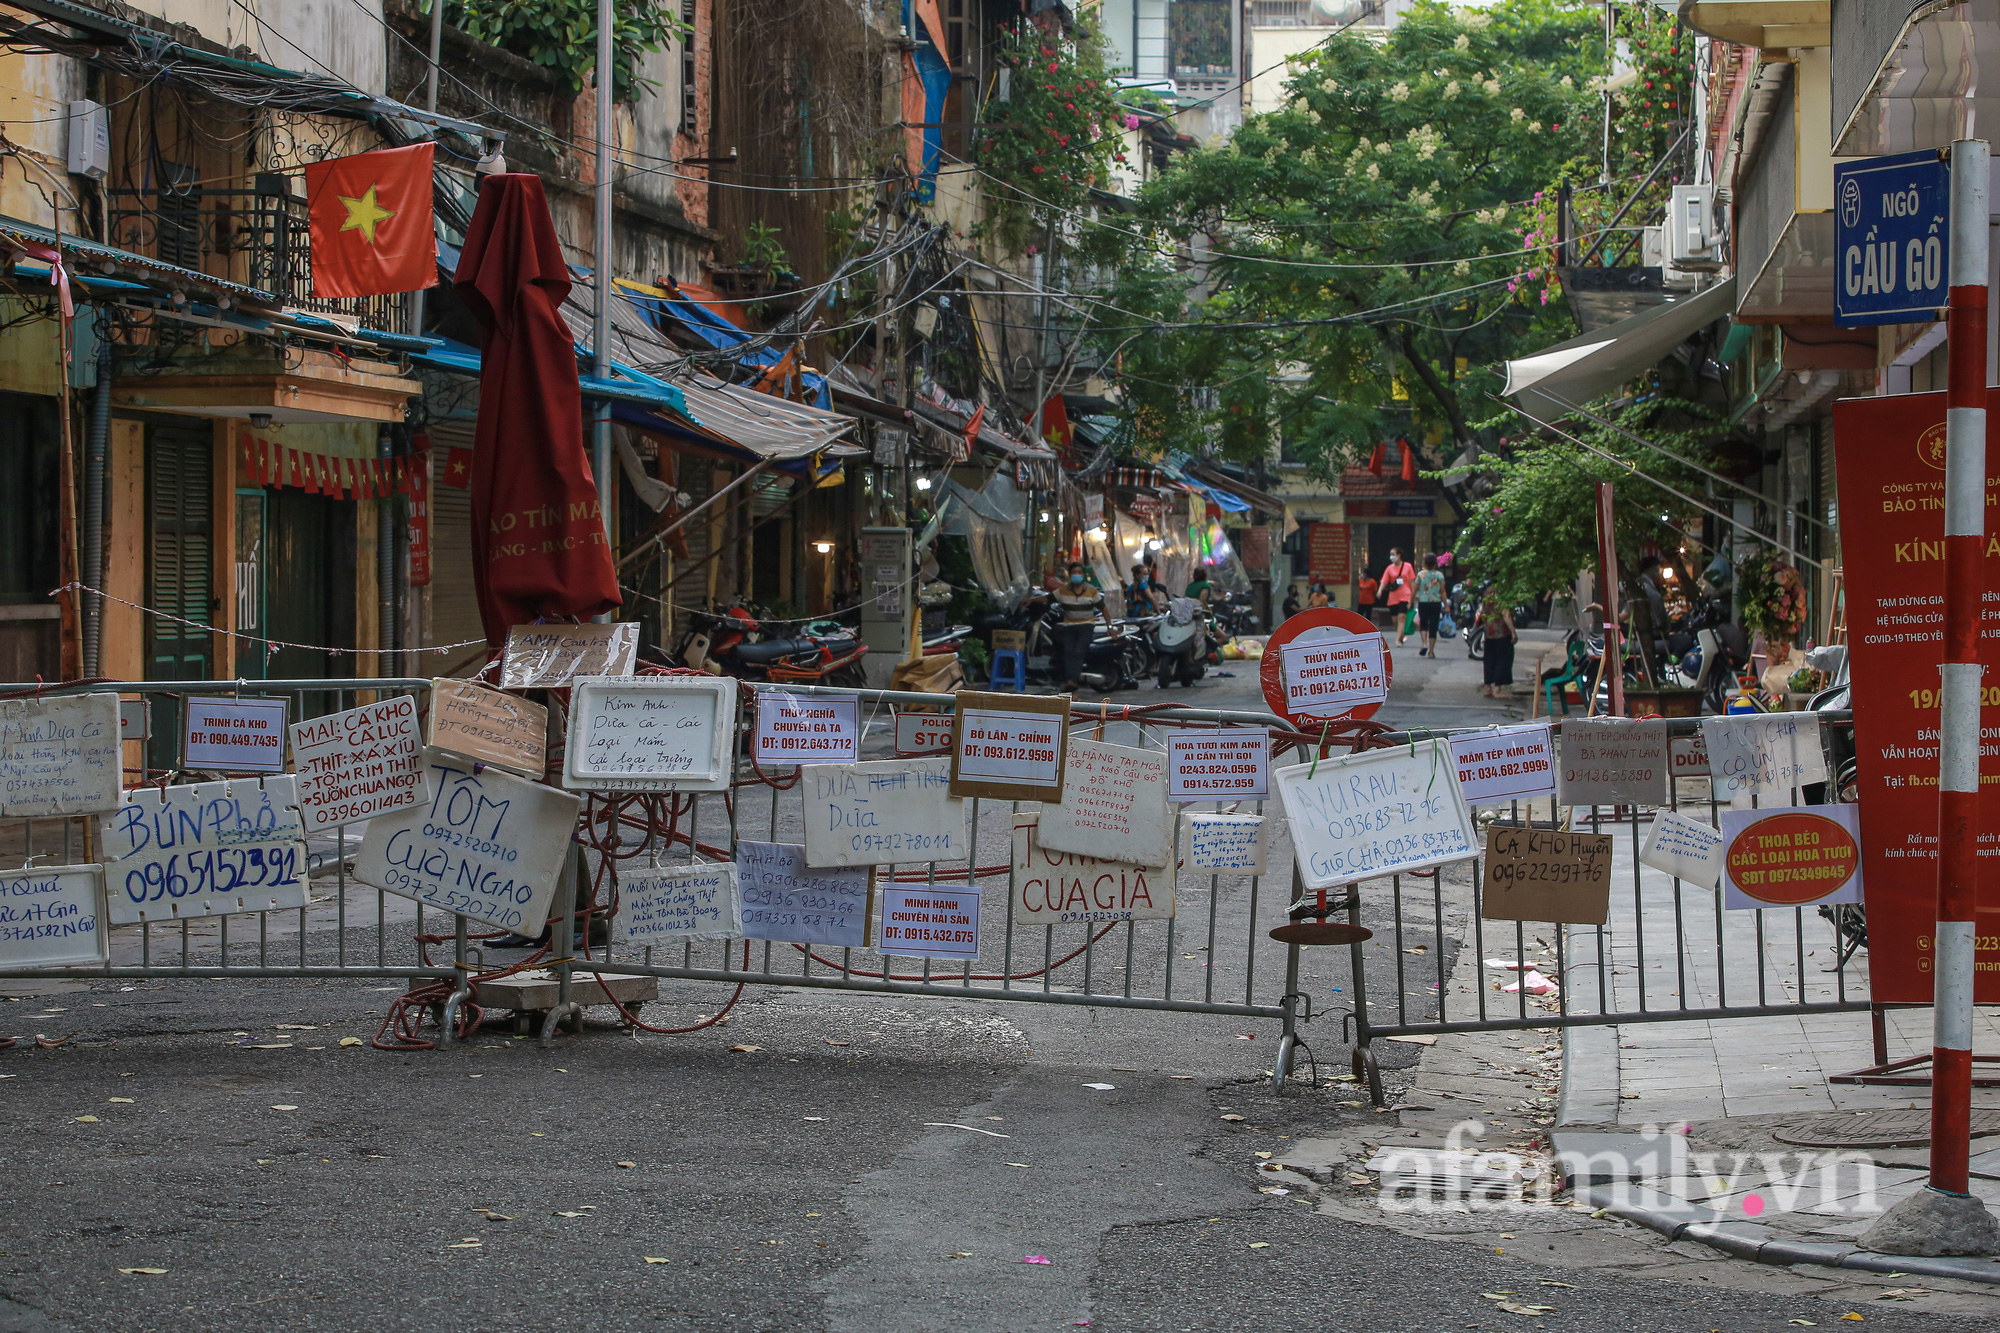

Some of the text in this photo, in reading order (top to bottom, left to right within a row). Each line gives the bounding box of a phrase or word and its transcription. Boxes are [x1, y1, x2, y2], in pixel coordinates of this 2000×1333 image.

[1883, 183, 1919, 218] NGÕ
[1845, 215, 1944, 297] CẦU GỖ
[1882, 482, 1928, 494] CÔNG TY
[1883, 494, 1945, 513] BẢO TÍN
[1877, 594, 1927, 609] TẠM DỪNG
[1877, 614, 1889, 627] HỆ
[1890, 612, 1923, 625] THỐNG
[1864, 631, 1929, 644] COVID-19 THEO
[1303, 648, 1360, 664] THỦY NGHĨA
[1300, 661, 1368, 679] CHUYÊN GÀ TA
[1290, 675, 1381, 698] ĐT: 0912.643.712
[605, 696, 636, 711] Kim
[203, 715, 268, 729] TRINH CÁ KHO
[806, 709, 836, 719] NGHĨA
[297, 701, 413, 746] MAI: CÁ KHO
[773, 720, 842, 734] CHUYÊN GÀ TA
[190, 731, 278, 748] ĐT: 090.449.7435
[348, 719, 412, 747] CÁ LỤC
[914, 731, 952, 747] STO
[970, 728, 1052, 744] BÒ LÂN CHỈNH
[1917, 726, 1941, 740] BÁN
[761, 737, 852, 750] ĐT: 0912.643.712
[1175, 740, 1261, 751] HOA TƯƠI KIM ANH
[1881, 743, 1939, 760] VẪN HOẠT
[307, 736, 416, 774] THỊT: XÁ XÍU
[965, 744, 1054, 763] ĐT: 093.612.9598
[1184, 750, 1252, 763] AI CẦN THÌ GỌI
[1459, 743, 1545, 765] MẮM TÉP KIM CHI
[1675, 750, 1709, 767] DỪN
[312, 754, 420, 790] TÔM THỊT
[1179, 763, 1258, 775] 0243.824.0596
[1459, 758, 1550, 784] ĐT: 034.682.9999
[1565, 769, 1653, 782] 0912635890
[1182, 777, 1255, 790] 0914.572.959
[1883, 775, 1905, 789] Tại:
[316, 790, 416, 824] 0396011443
[430, 764, 511, 841] TÔM
[114, 802, 202, 860] BÚN
[1758, 830, 1820, 849] THOA BÉO
[1907, 832, 1923, 844] Rất
[422, 823, 518, 862] 0972520710
[851, 834, 950, 852] 0979278011
[1494, 830, 1520, 856] CÁ
[1527, 832, 1567, 855] KHO
[1731, 845, 1852, 867] CÁC LOẠI HOA TƯƠI
[1884, 846, 1928, 858] kính chúc
[1492, 862, 1604, 893] 0962299776
[1741, 864, 1846, 886] SĐT 0974349645
[384, 869, 522, 928] 0972520710
[904, 898, 959, 912] MINH HẠNH
[891, 909, 971, 925] CHUYÊN HẢI SẢN
[1061, 911, 1132, 922] 0915827038
[885, 925, 975, 944] ĐT: 0915.432.675
